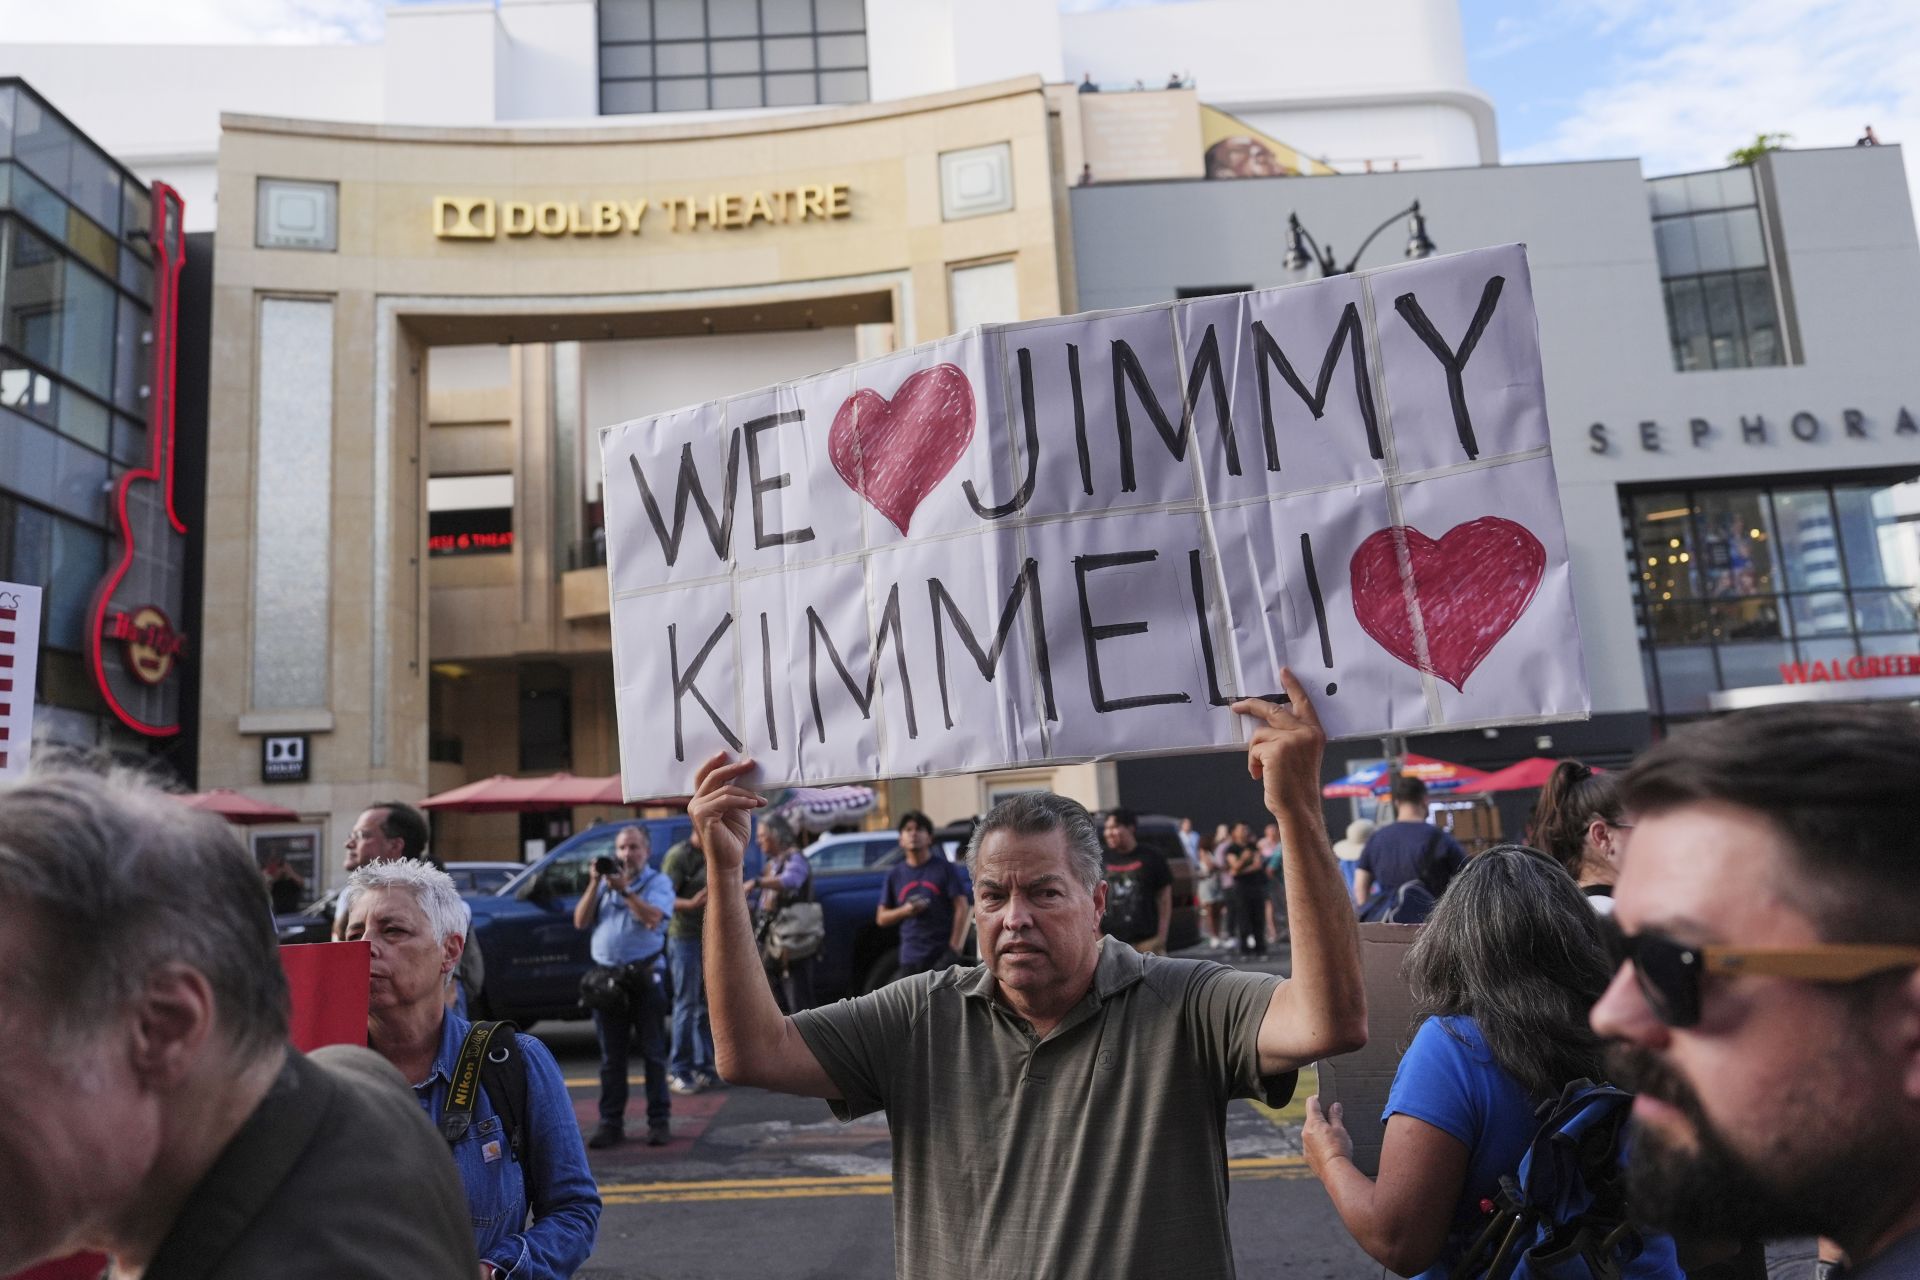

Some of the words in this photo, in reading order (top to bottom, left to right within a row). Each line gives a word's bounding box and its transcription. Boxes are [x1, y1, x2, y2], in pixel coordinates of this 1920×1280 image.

[503, 199, 648, 236] DOLBY
[663, 183, 852, 233] THEATRE
[629, 408, 815, 567] WE
[961, 275, 1506, 519] JIMMY
[1589, 406, 1920, 453] SEPHORA
[668, 533, 1338, 762] KIMMEL!
[454, 1062, 474, 1105] Nikon
